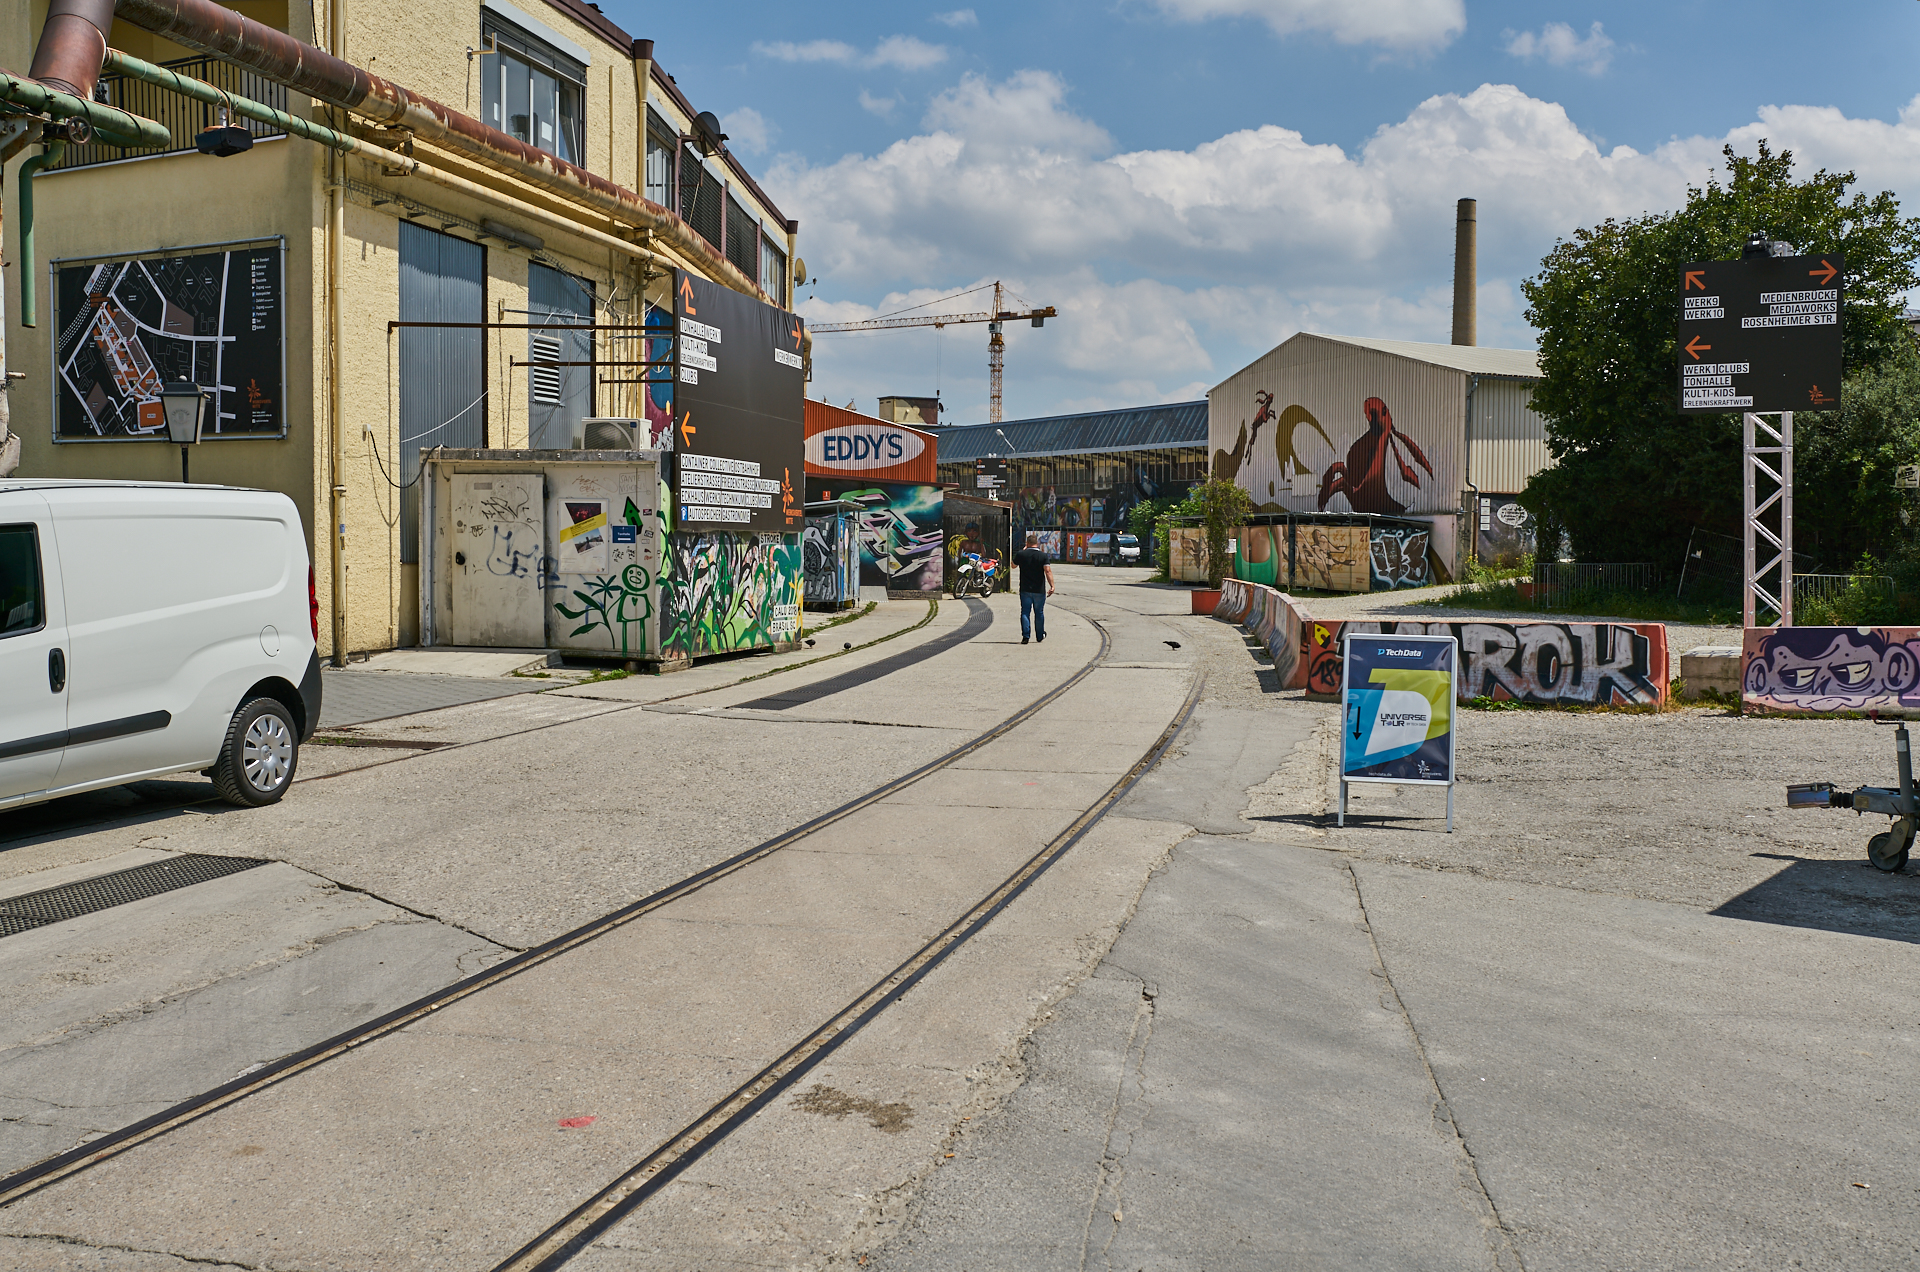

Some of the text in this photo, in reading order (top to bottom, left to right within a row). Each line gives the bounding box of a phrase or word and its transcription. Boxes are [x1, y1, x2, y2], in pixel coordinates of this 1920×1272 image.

[1686, 298, 1718, 307] WERK9
[1762, 290, 1836, 303] MEDIENBRÜCKE
[1686, 309, 1723, 318] WERK10
[1771, 303, 1836, 314] MEDIAWORKS
[1744, 314, 1836, 326] ROSENHEIMER STR.
[681, 320, 704, 336] TONHALLE
[1685, 364, 1748, 374] WERK1 CLUBS
[681, 369, 696, 382] CLUBS
[1685, 377, 1730, 386] TONHALLE
[1685, 389, 1734, 398] KULTI-KIDS
[824, 433, 903, 461] EDDY'S
[682, 456, 708, 469] CONTAINER
[710, 459, 734, 472] COLLECTIVE
[682, 473, 720, 487] ATELIERSTRASSE
[682, 490, 703, 502] ECKHAUS
[690, 509, 720, 520] AUTOSPEICHER
[723, 510, 749, 521] GASTRONOMIE
[760, 534, 780, 544] STROKE
[1360, 531, 1368, 542] 27
